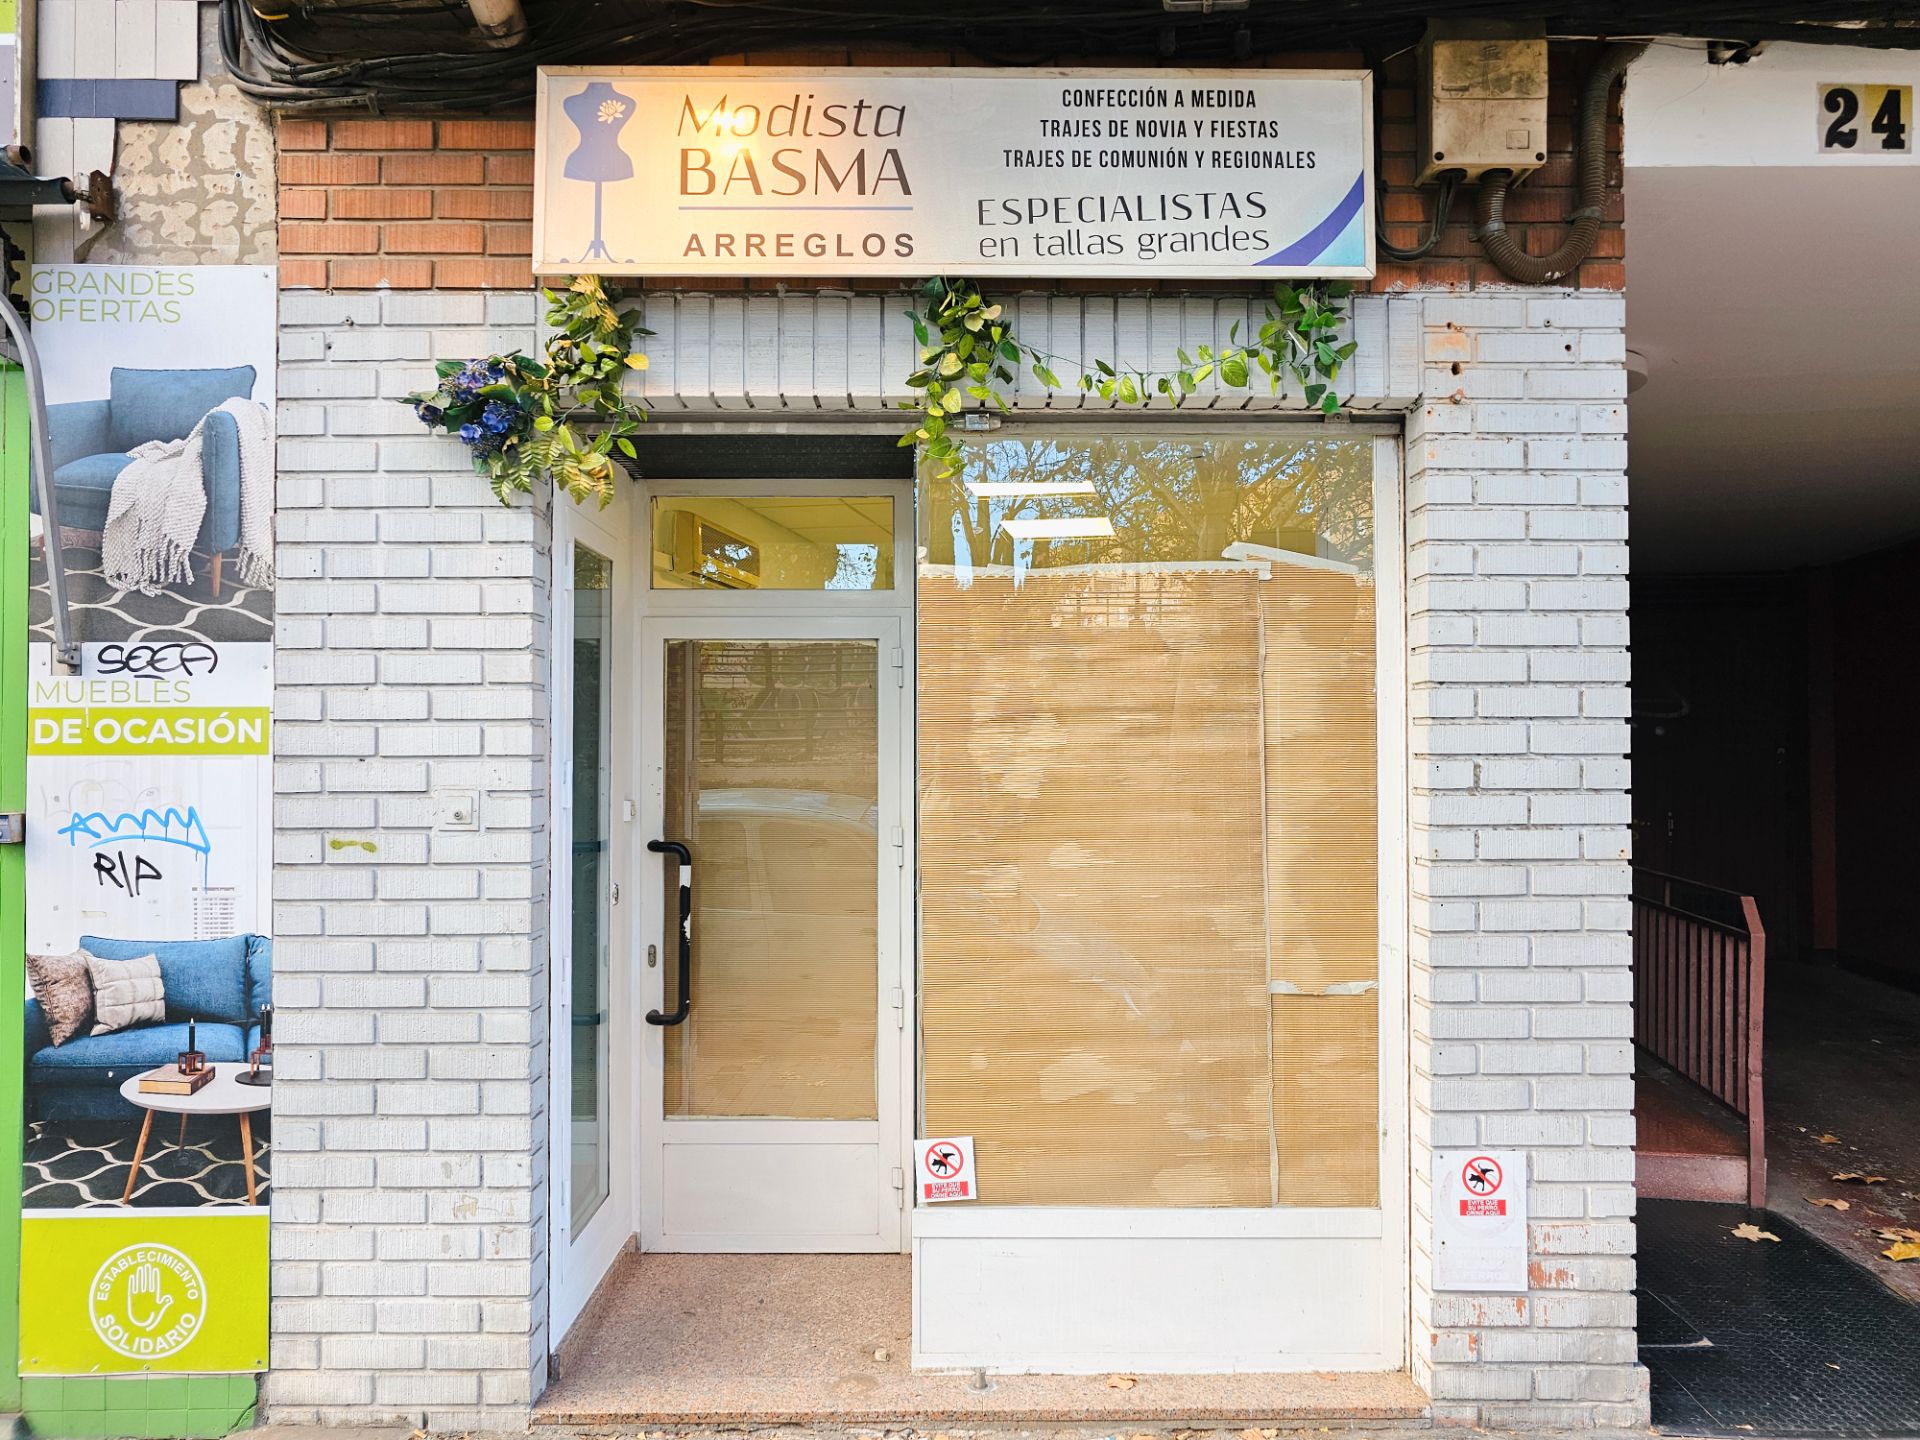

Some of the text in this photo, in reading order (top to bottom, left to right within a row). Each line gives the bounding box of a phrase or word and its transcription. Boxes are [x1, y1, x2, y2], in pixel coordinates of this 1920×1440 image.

[1062, 86, 1257, 108] CONFECCIÓN A MEDIDA
[677, 93, 906, 138] Modista
[1040, 119, 1279, 139] TRAJES DE NOVIA Y FIESTAS
[1824, 87, 1906, 150] 24
[679, 148, 913, 196] BASMA
[1003, 146, 1316, 169] TRAJES DE COMUNIÓN Y REGIONALES
[977, 191, 1268, 227] ESPECIALISTAS
[683, 232, 914, 258] ARREGLOS
[979, 224, 1270, 260] en tallas grandes
[31, 270, 195, 297] GRANDES
[30, 298, 182, 323] OFERTAS
[35, 680, 191, 704] MUEBLES
[34, 712, 262, 744] DE OCASIÓN
[97, 1250, 199, 1301] ESTABLECIMIENTO
[100, 1313, 196, 1353] SOLIDARIO
